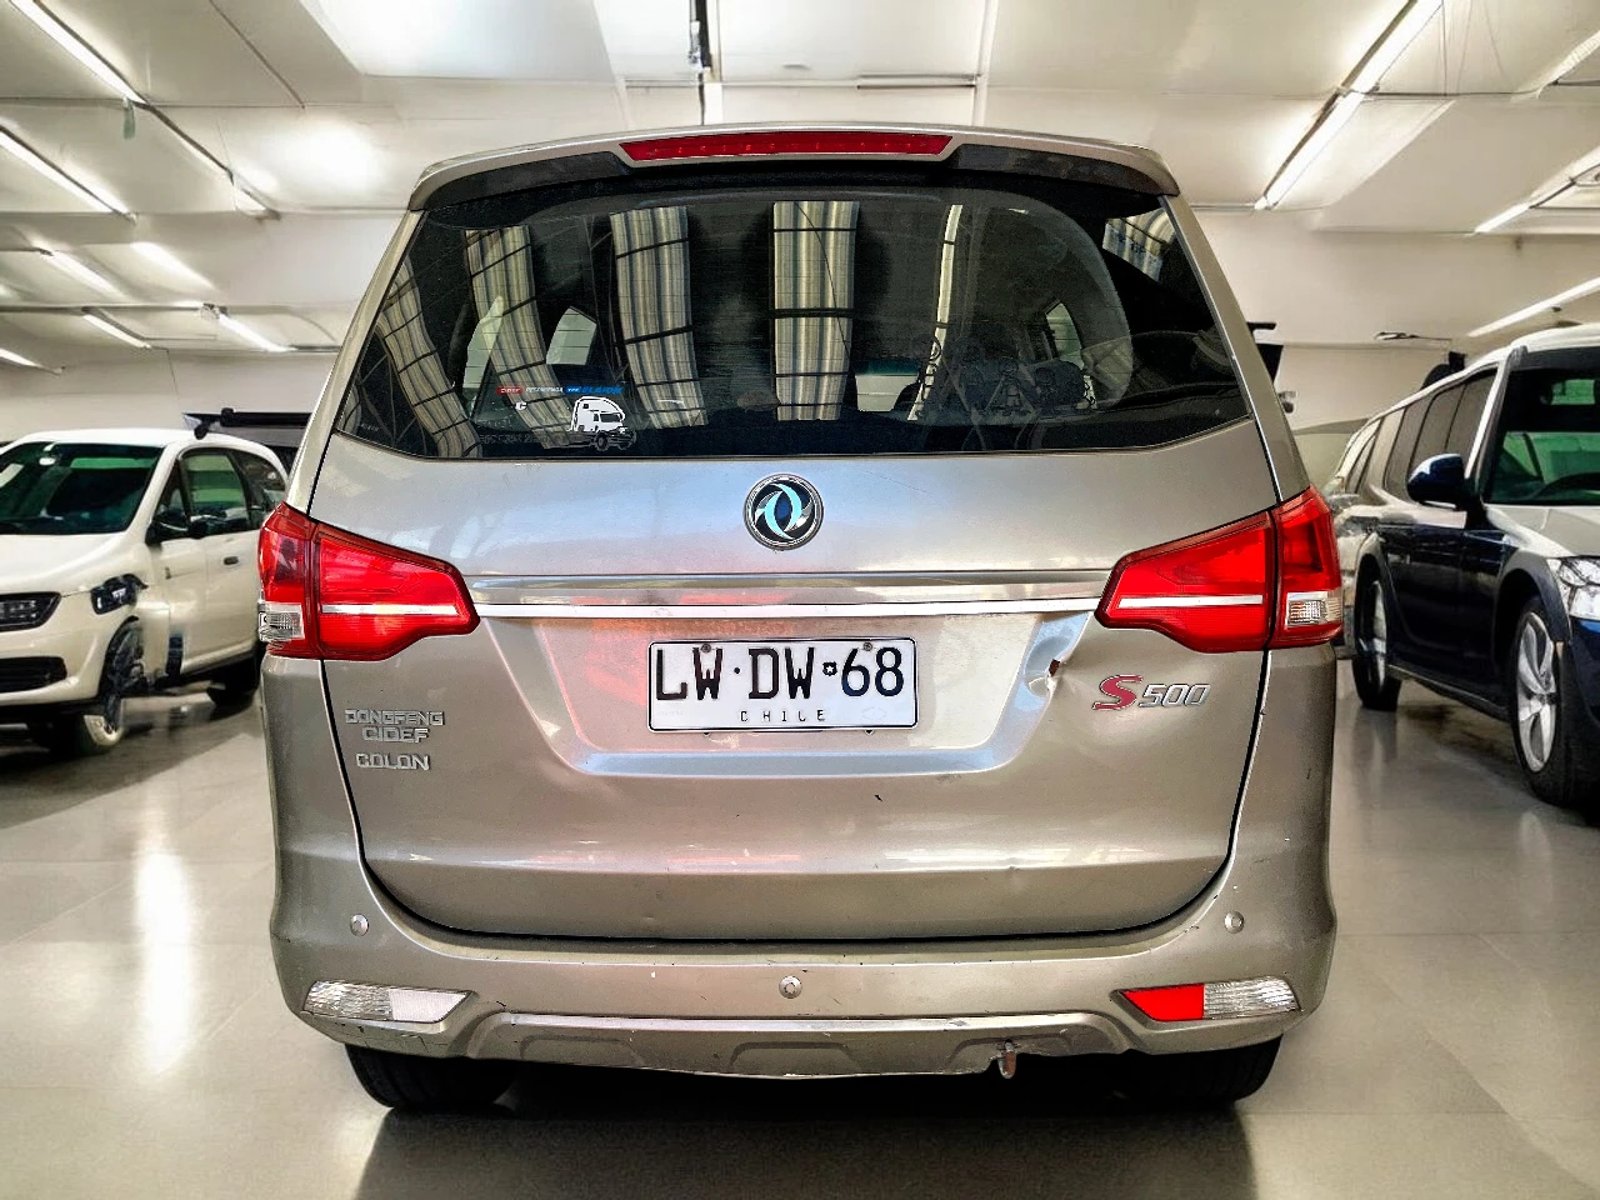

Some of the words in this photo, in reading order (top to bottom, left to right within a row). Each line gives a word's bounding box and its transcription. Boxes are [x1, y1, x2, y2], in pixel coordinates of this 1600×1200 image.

[344, 709, 444, 726] DONGFENG
[740, 709, 826, 723] CHILE
[362, 726, 430, 743] CIDEF
[355, 753, 430, 771] COLON
